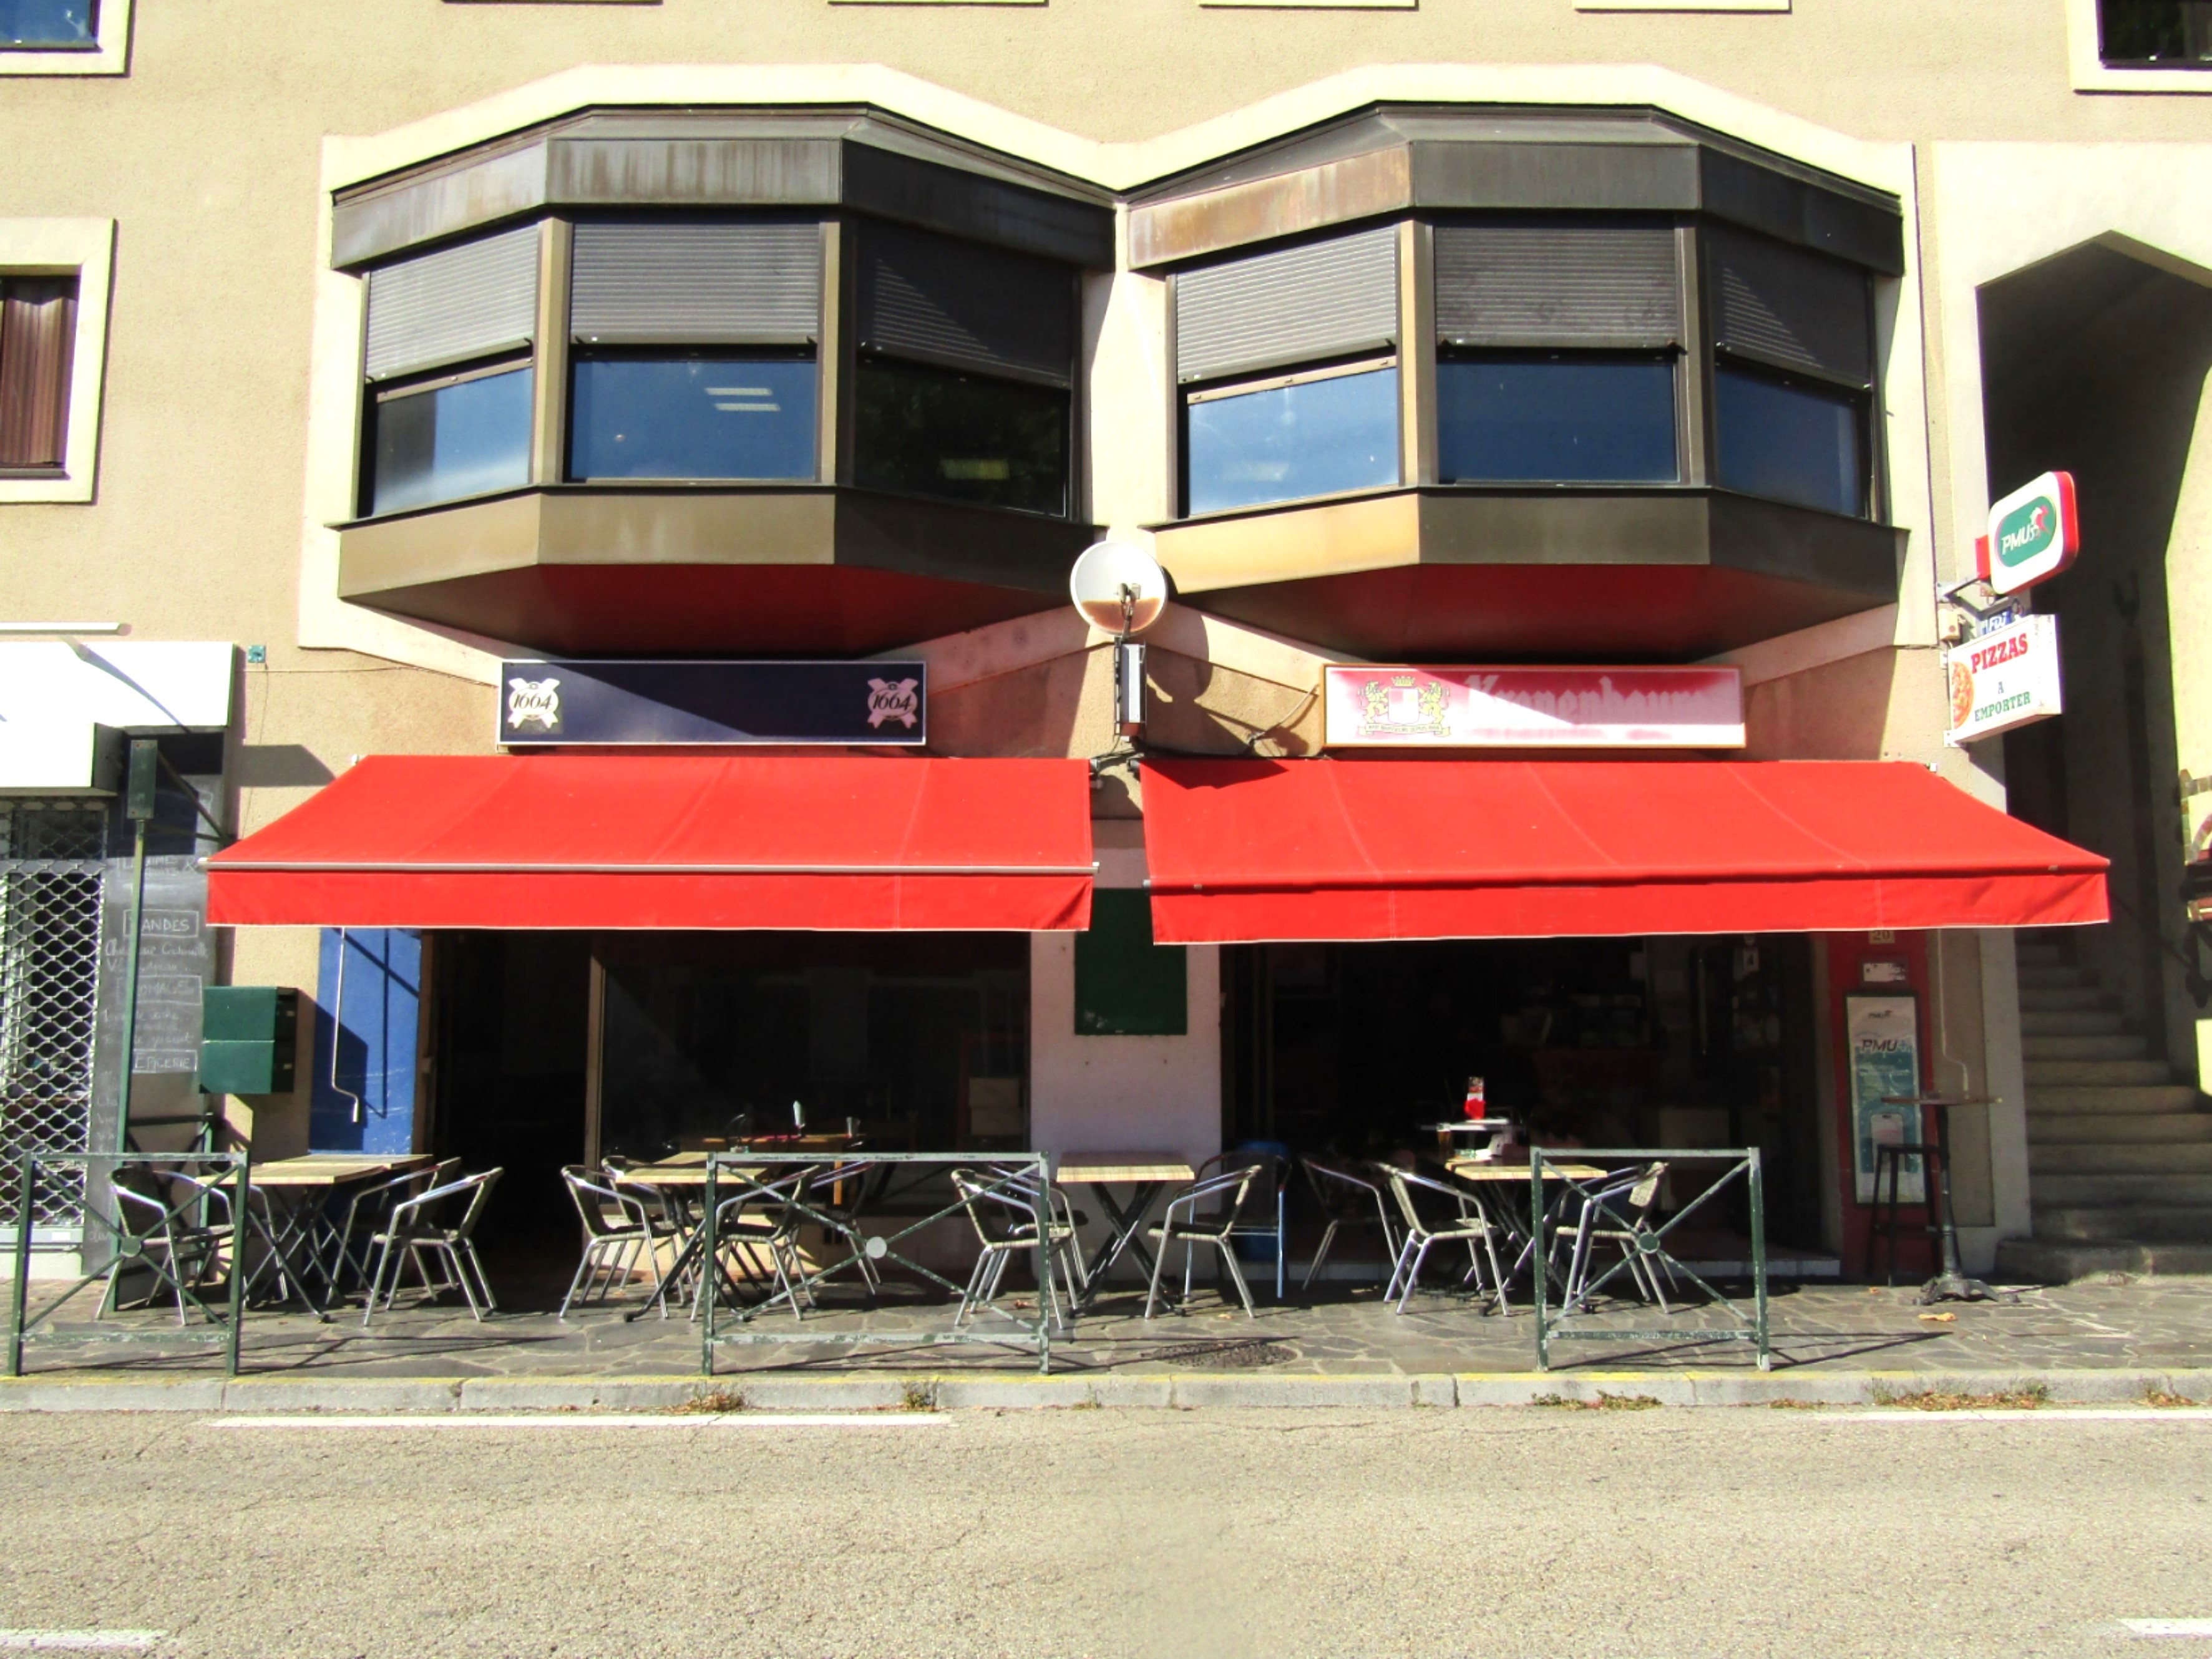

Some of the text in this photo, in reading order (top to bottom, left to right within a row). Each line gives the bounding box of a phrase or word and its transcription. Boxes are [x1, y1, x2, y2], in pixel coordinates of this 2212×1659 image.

[2000, 524, 2030, 555] PMU
[1970, 633, 2029, 674] PIZZAS
[514, 689, 553, 712] 1664
[872, 689, 912, 712] 1664
[1463, 674, 1708, 722] Kronenbour
[1997, 681, 2004, 694] A
[1974, 691, 2031, 722] EMPORTER
